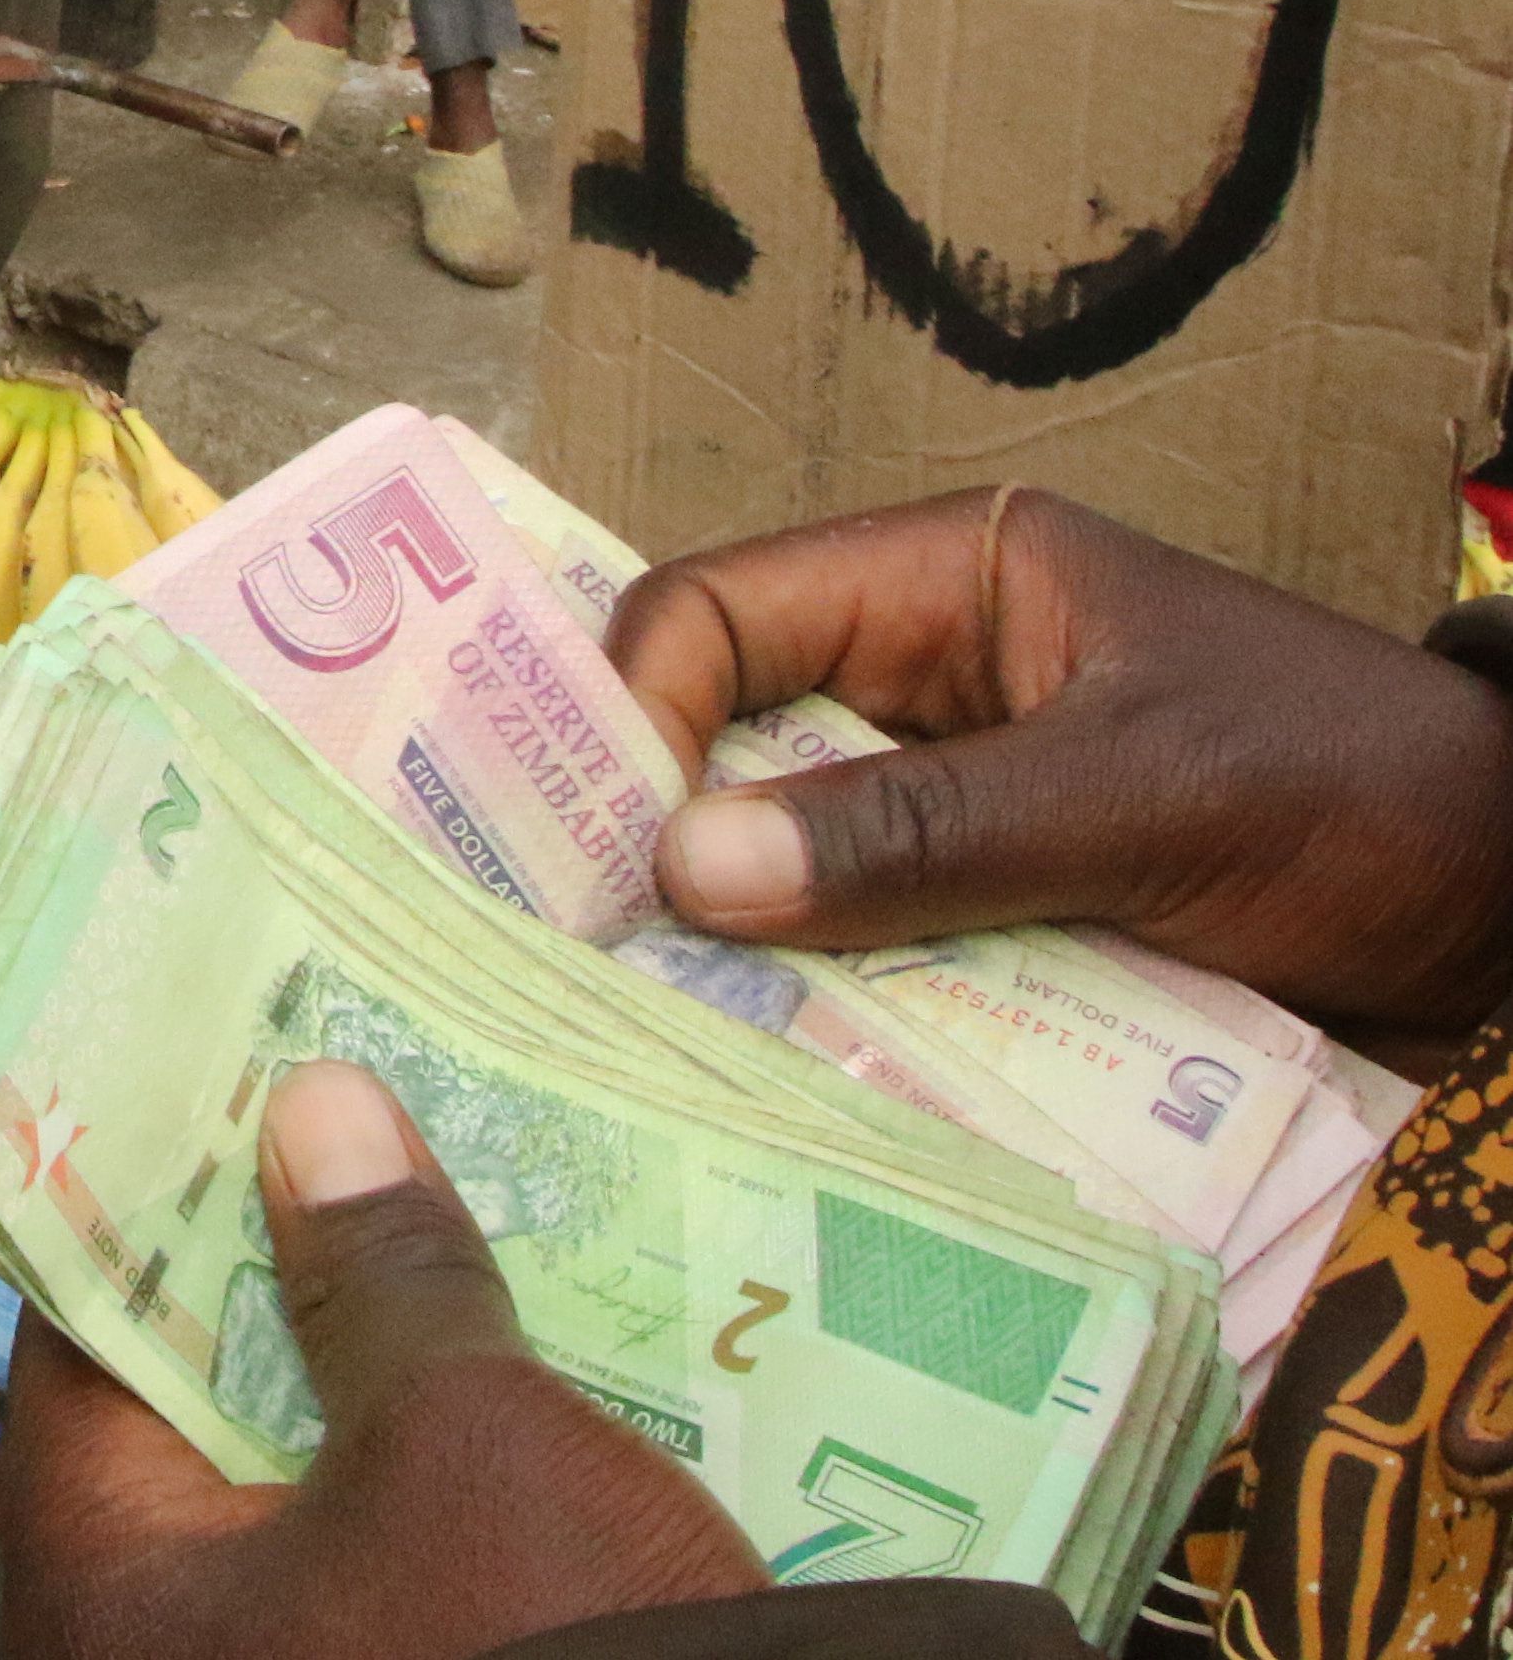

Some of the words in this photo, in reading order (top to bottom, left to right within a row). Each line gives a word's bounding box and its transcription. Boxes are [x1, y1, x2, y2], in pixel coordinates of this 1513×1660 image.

[239, 465, 478, 674] 5
[447, 640, 507, 697] OF
[489, 701, 661, 922] ZIMBABWE
[477, 607, 619, 793] RESERVE
[605, 784, 663, 858] BA
[139, 762, 201, 882] 2
[406, 758, 454, 816] FIVE
[447, 816, 527, 911] DOLLAR
[926, 973, 1075, 1047] 1437537
[1011, 971, 1119, 1030] DOLLARS
[1123, 1021, 1175, 1058] FIVE
[1149, 1054, 1245, 1148] 5
[711, 1278, 791, 1375] 2
[630, 1410, 689, 1453] TWO
